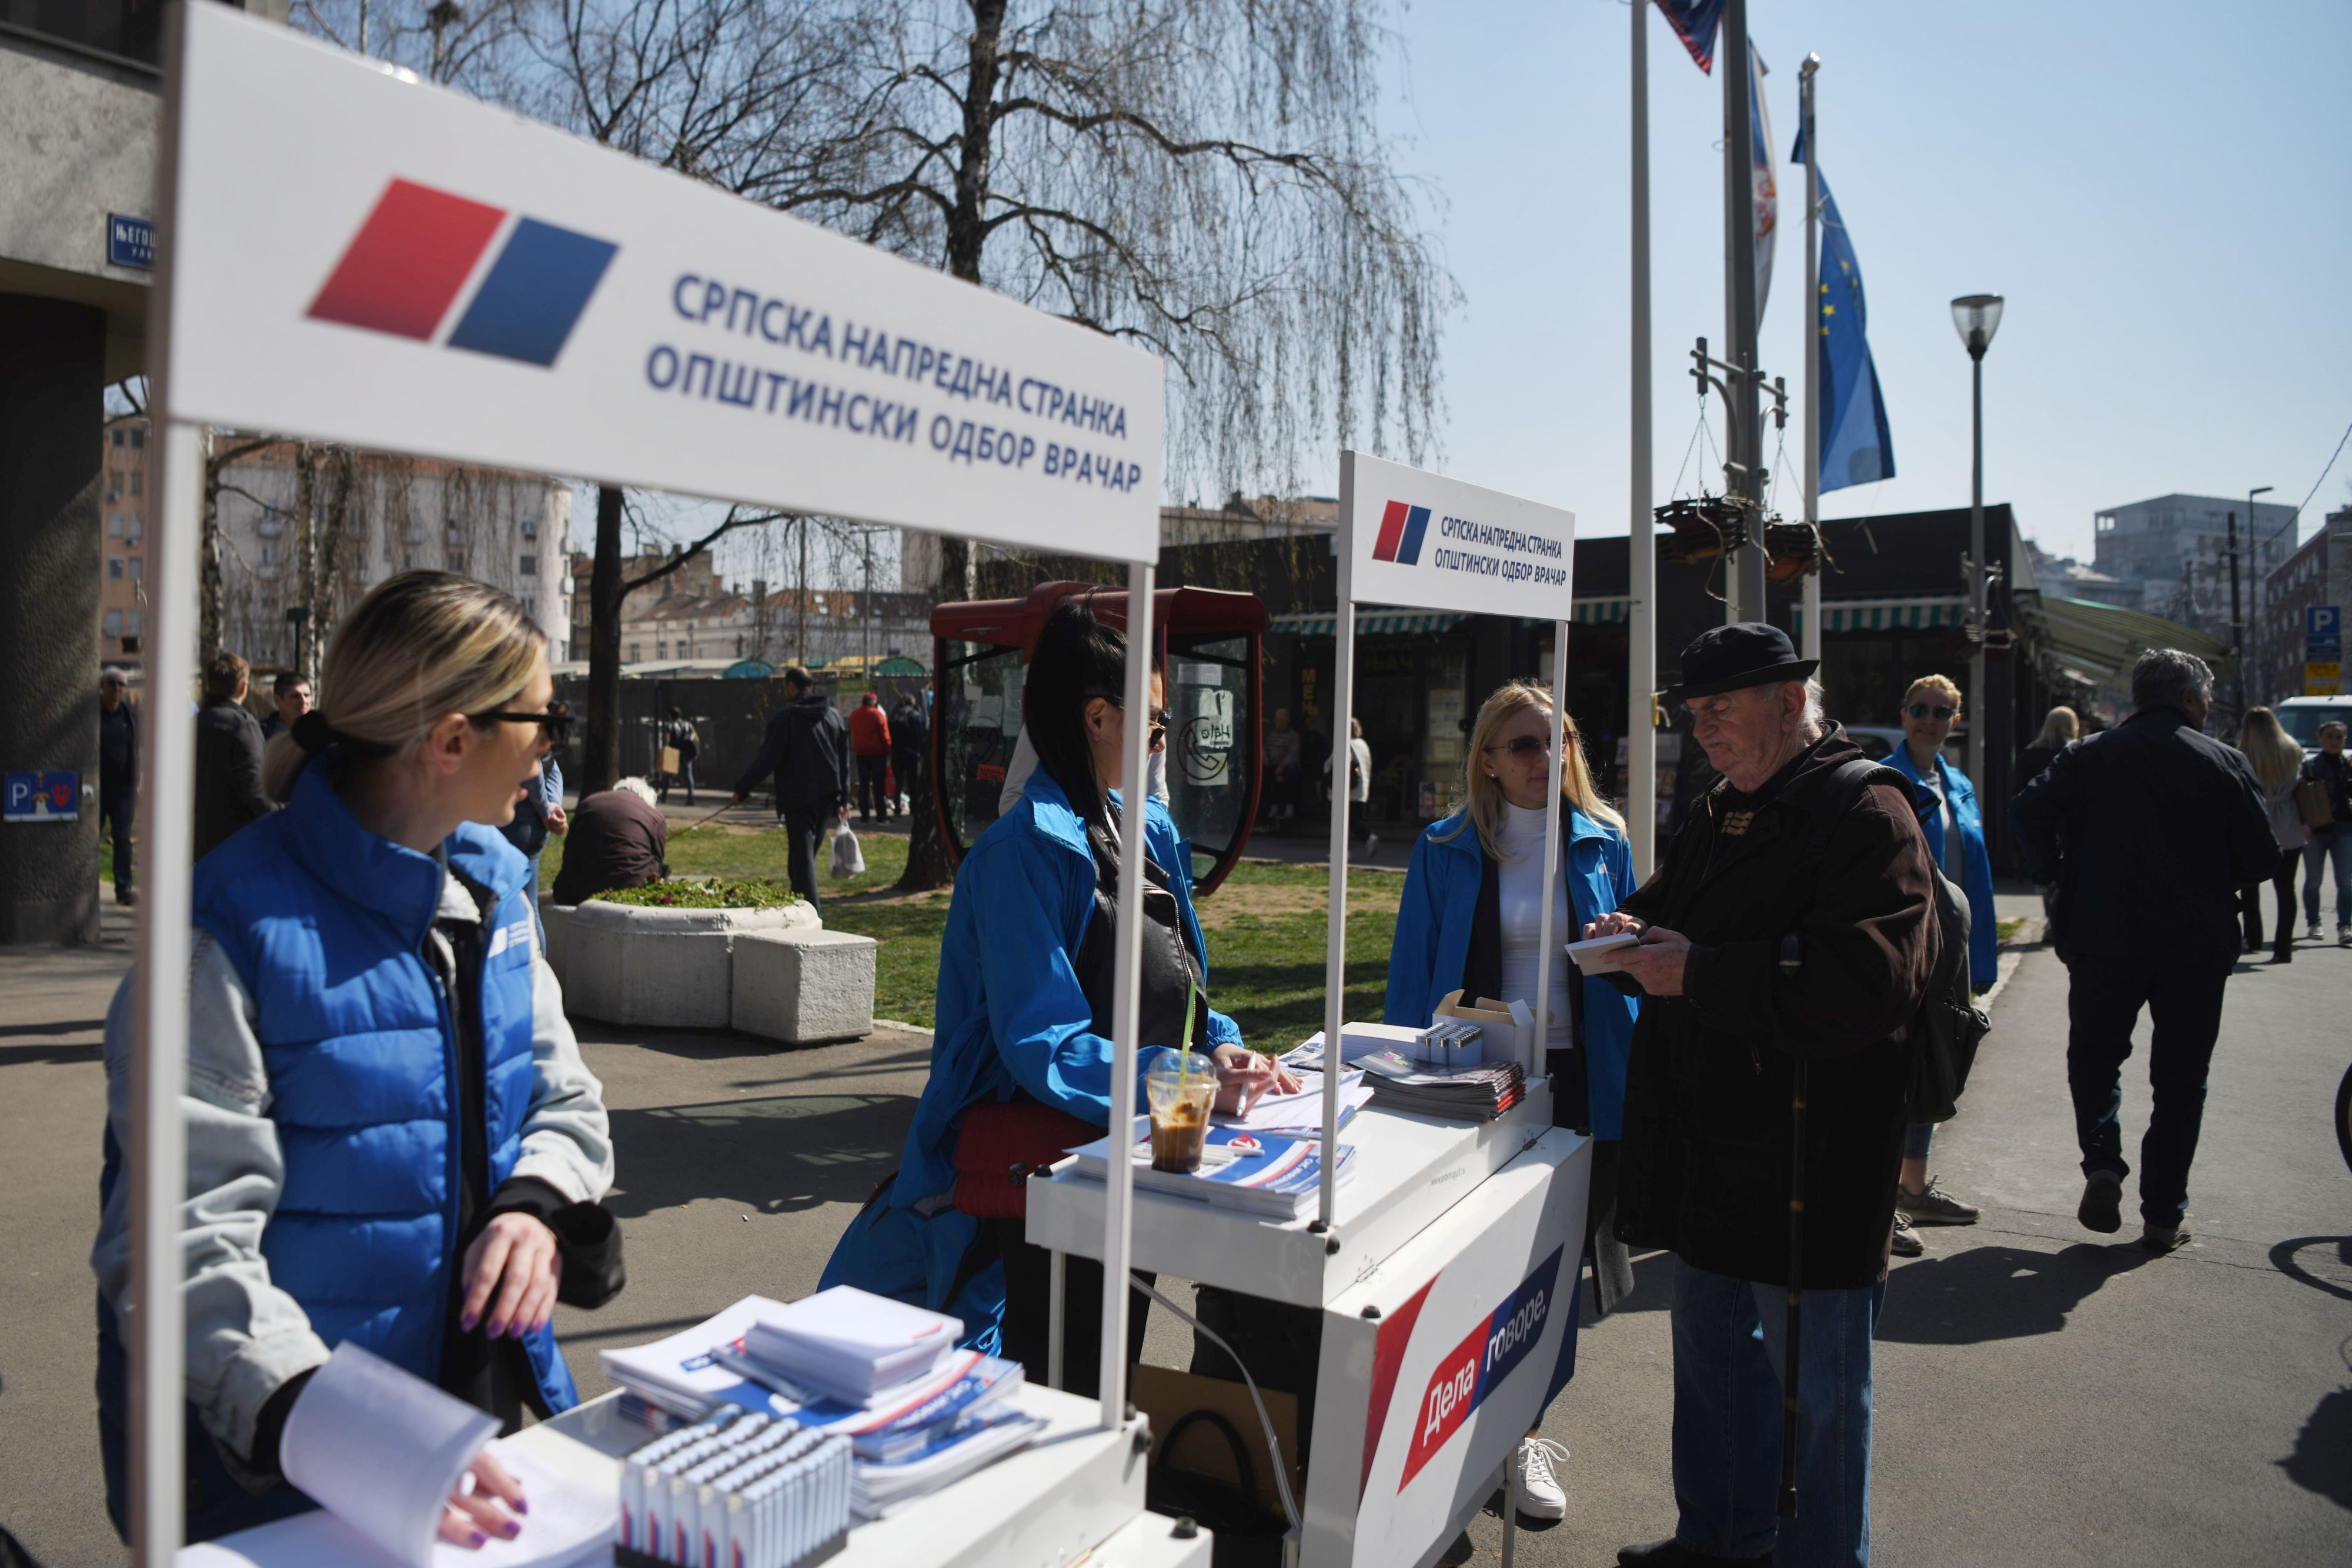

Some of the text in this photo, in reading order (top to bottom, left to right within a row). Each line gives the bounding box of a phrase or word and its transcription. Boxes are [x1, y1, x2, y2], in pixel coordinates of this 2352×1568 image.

[672, 273, 1127, 441] СРПСКА НАПРЕДНА СТРАНКА
[646, 345, 1141, 494] ОПШТИНСКИ ОДБОР ВРАЧАР
[1441, 516, 1562, 559] СРПСКА НАПРЕДНА СТРАНКА
[1435, 548, 1566, 587] ОПШТИНСКИ ОДБОР ВРАЧАР
[2314, 609, 2333, 632] P
[12, 783, 28, 807] P
[1422, 1289, 1546, 1449] Дела говоре.
